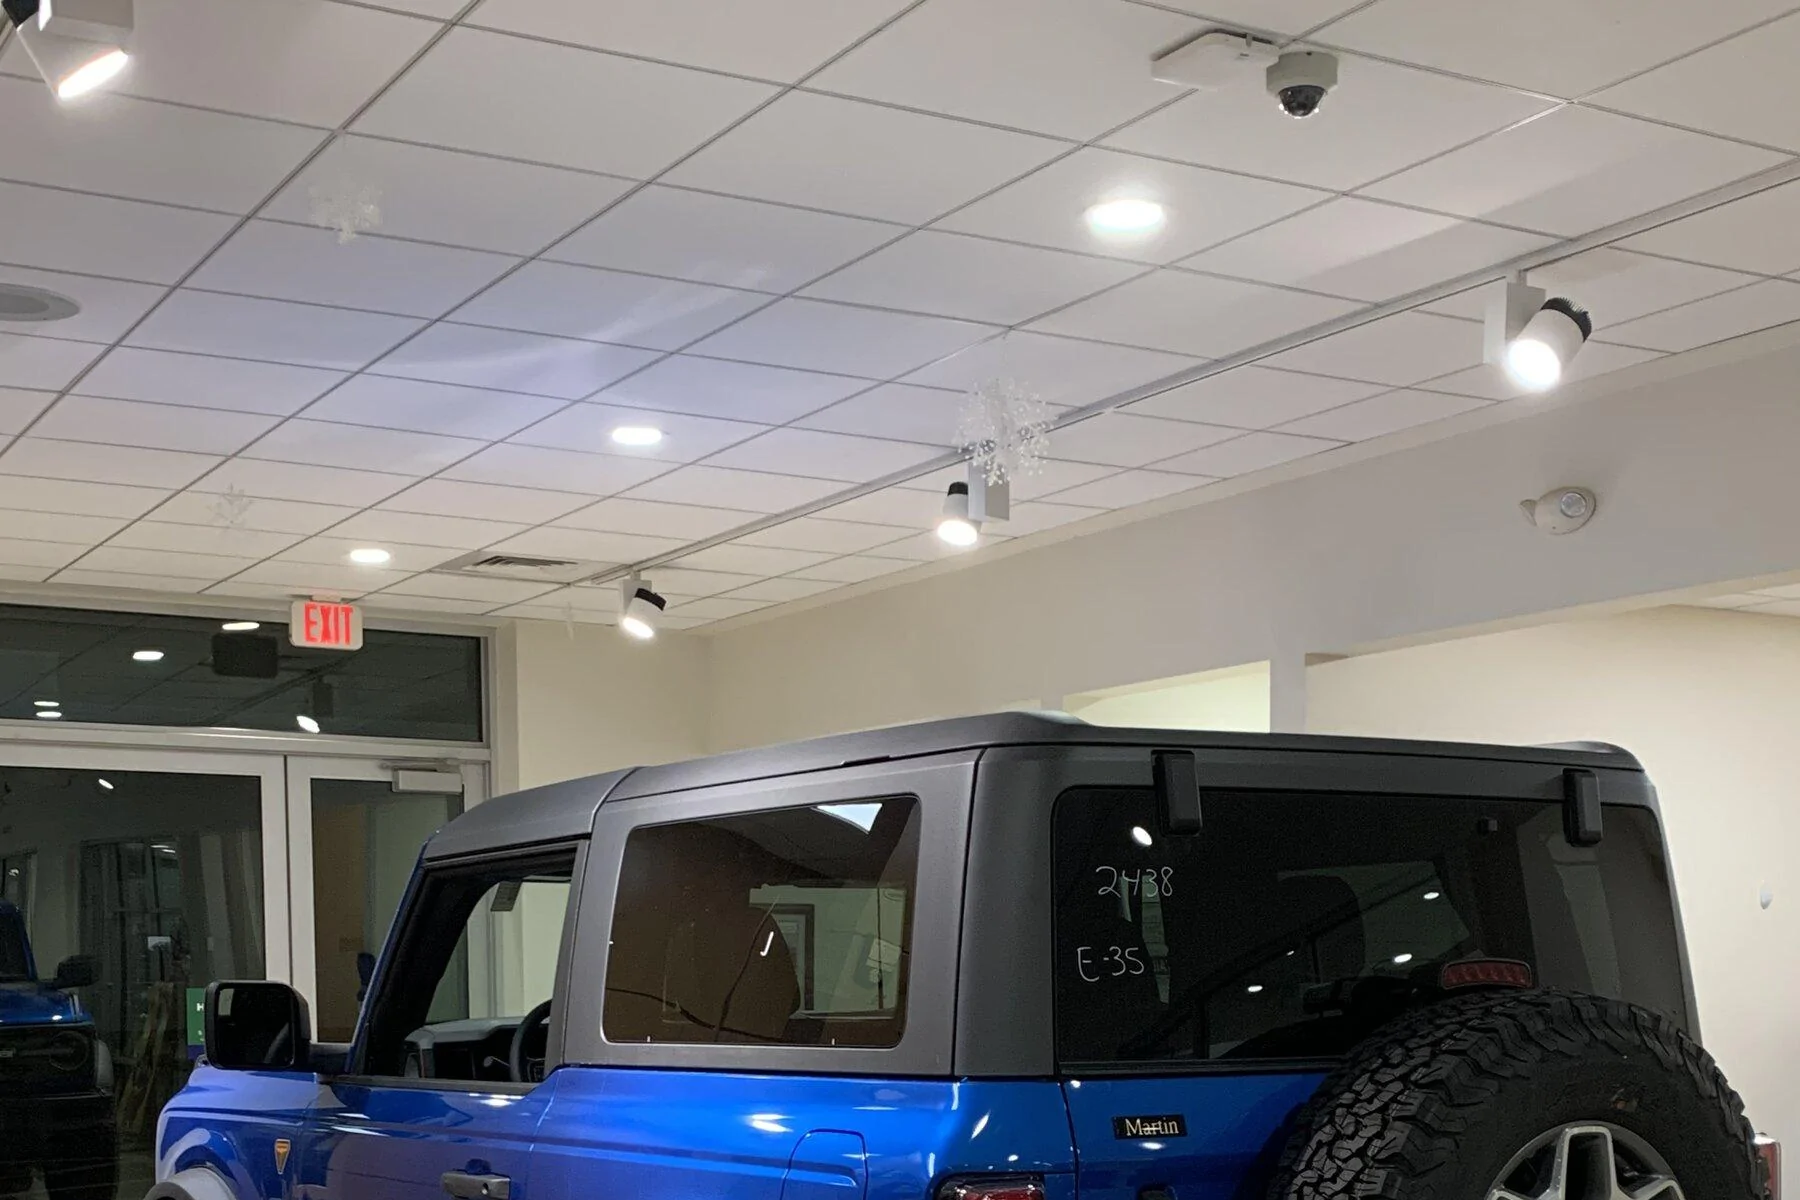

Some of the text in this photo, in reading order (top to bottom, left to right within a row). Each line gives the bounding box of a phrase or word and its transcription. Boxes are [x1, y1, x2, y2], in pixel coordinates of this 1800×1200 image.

[304, 602, 353, 645] EXIT
[1095, 865, 1174, 898] 2438
[1124, 1117, 1180, 1137] Martin
